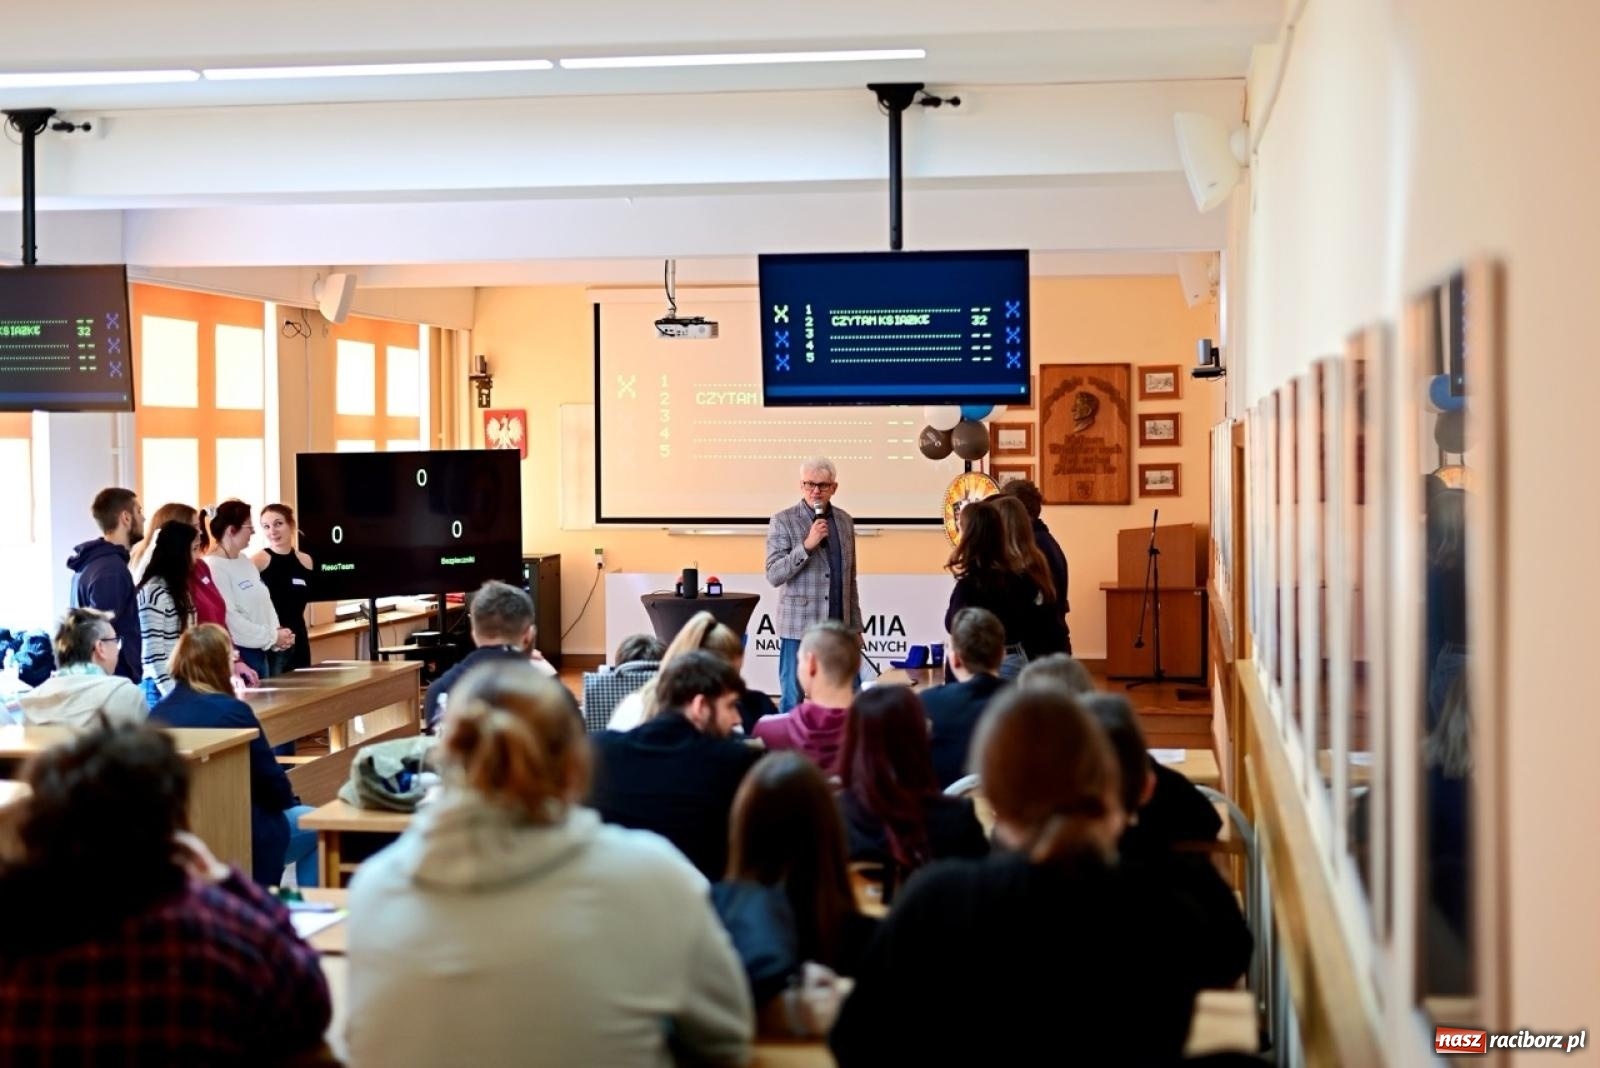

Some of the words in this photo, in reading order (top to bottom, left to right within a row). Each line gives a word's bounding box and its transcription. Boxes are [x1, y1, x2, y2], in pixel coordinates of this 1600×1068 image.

[805, 304, 812, 315] 1
[805, 316, 814, 327] 2
[831, 315, 877, 327] CZYTAM
[971, 315, 988, 326] 32
[77, 326, 91, 337] 32
[805, 328, 814, 339] 3
[805, 340, 814, 351] 4
[805, 352, 815, 363] 5
[660, 374, 668, 388] 1
[660, 392, 670, 405] 2
[696, 392, 757, 405] CZYTAM
[660, 409, 670, 422] 3
[659, 427, 670, 440] 4
[659, 444, 670, 458] 5
